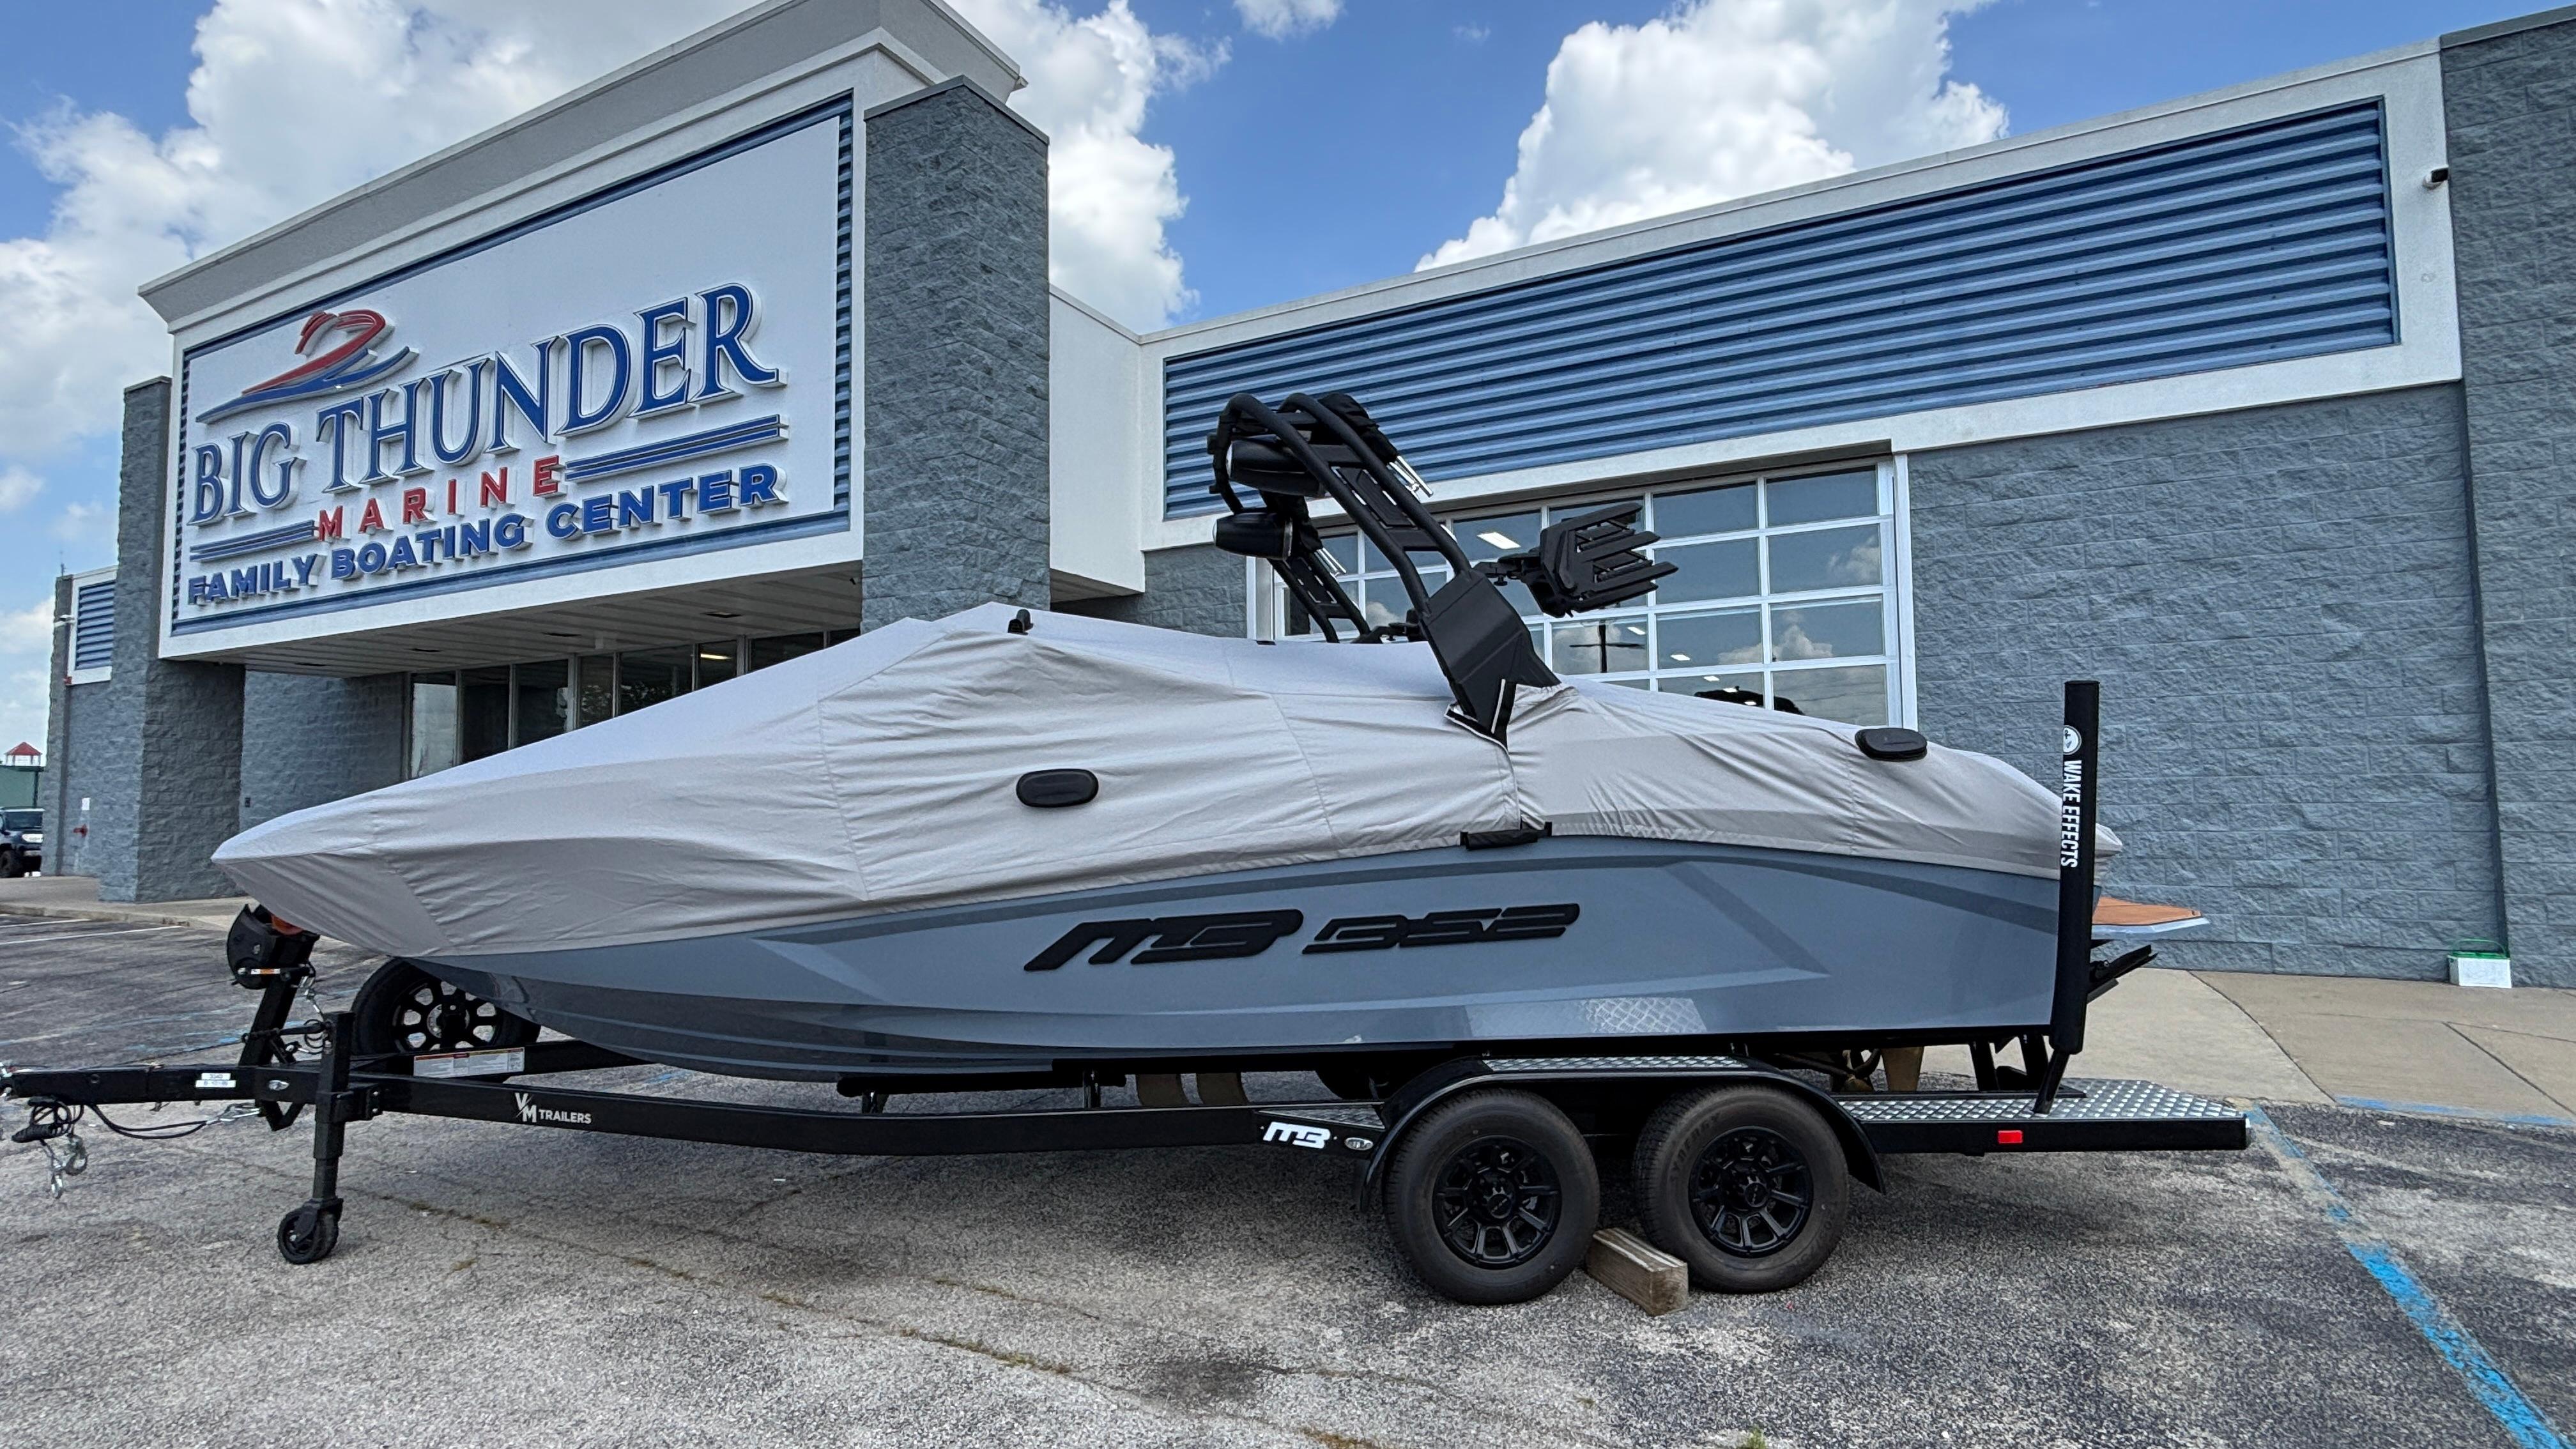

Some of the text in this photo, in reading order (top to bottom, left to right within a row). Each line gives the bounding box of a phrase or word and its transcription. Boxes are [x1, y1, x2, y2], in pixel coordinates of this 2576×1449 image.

[187, 282, 779, 526] BIG THUNDER
[188, 463, 778, 605] FAMILY BOATING CENTER
[319, 455, 560, 541] MARINE
[2060, 760, 2082, 868] WAKE EFFECTS
[539, 1108, 592, 1124] TRAILERS
